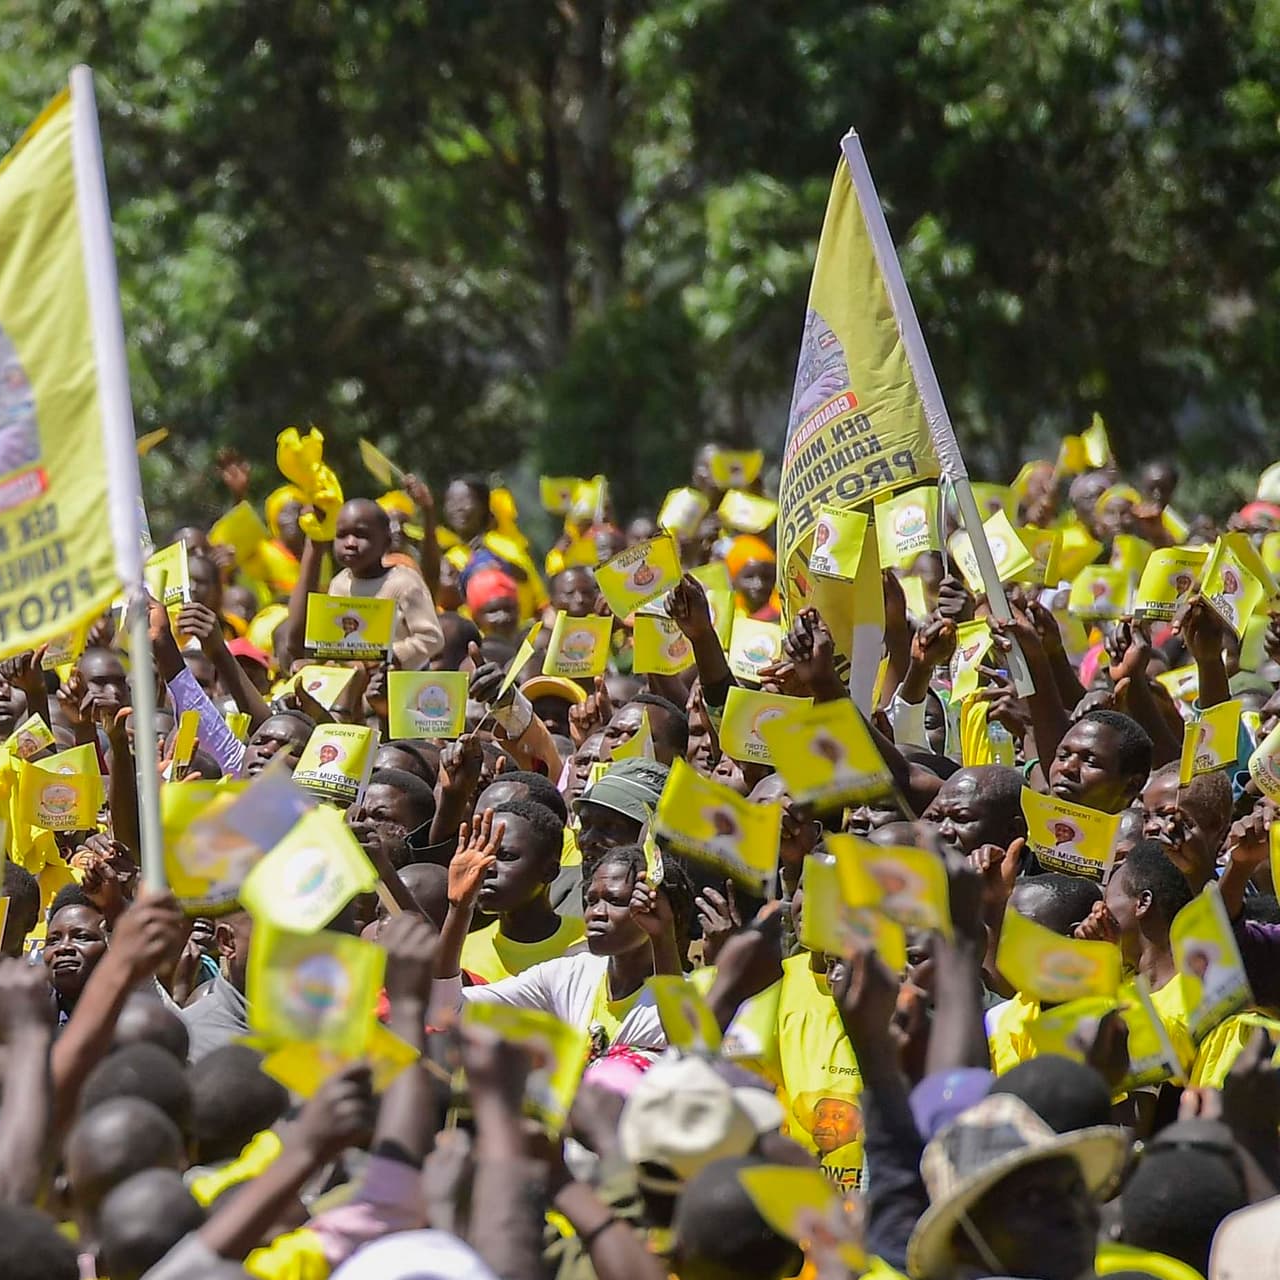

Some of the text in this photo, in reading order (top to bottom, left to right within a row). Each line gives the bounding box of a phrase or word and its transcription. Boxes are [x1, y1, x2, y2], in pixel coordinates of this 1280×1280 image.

[747, 749, 762, 757] THE
[1054, 805, 1092, 821] PRESIDENT
[1057, 851, 1104, 868] MUSEVENI
[1064, 861, 1077, 871] THE
[1077, 864, 1098, 875] GAINS
